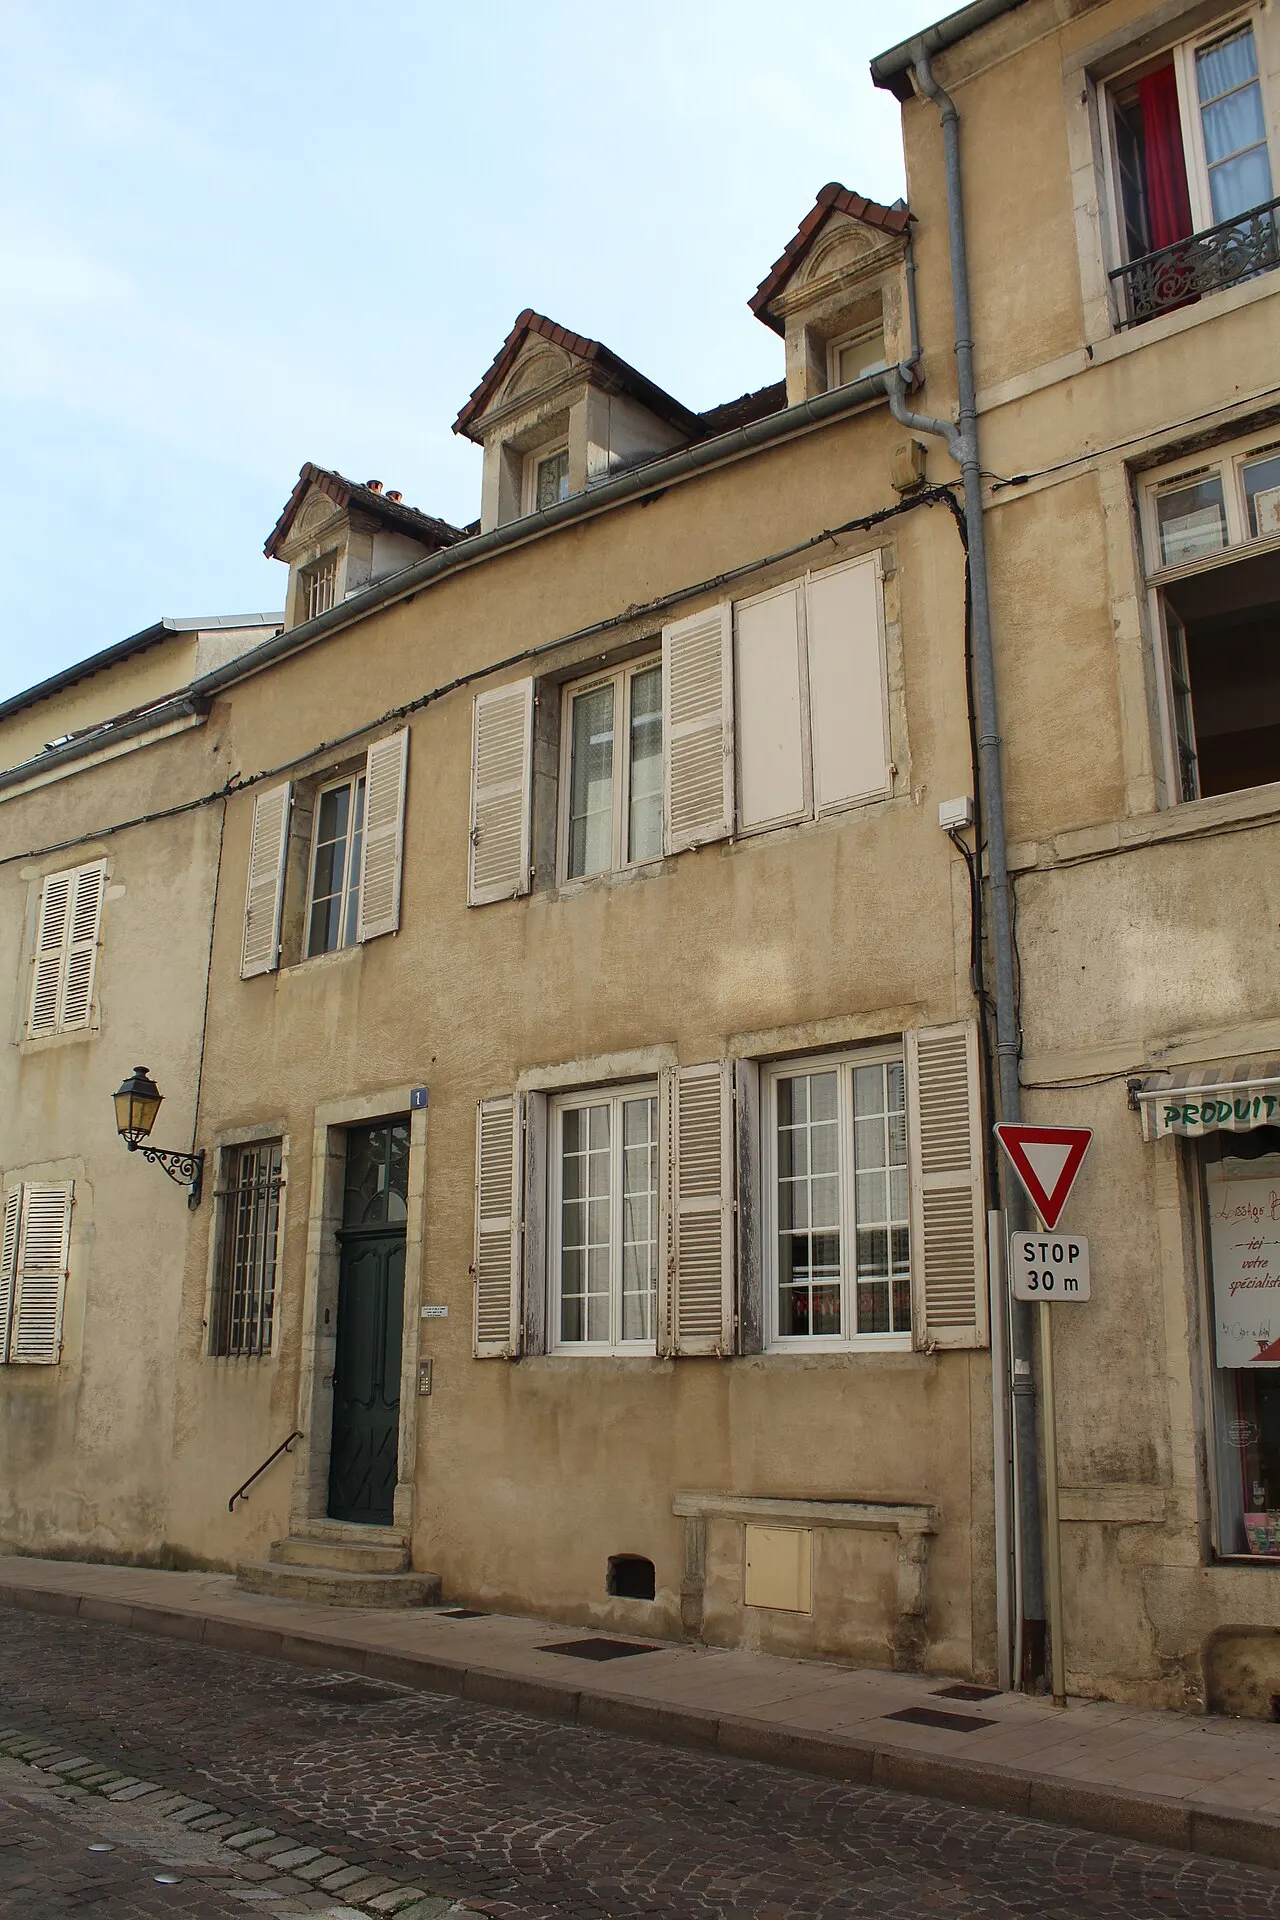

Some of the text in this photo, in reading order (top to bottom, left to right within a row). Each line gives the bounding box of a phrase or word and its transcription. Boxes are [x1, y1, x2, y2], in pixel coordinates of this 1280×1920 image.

[1163, 1095, 1280, 1128] PRODUIT
[1023, 1242, 1080, 1264] STOP
[1241, 1255, 1269, 1269] votre
[1027, 1270, 1079, 1291] 30 m
